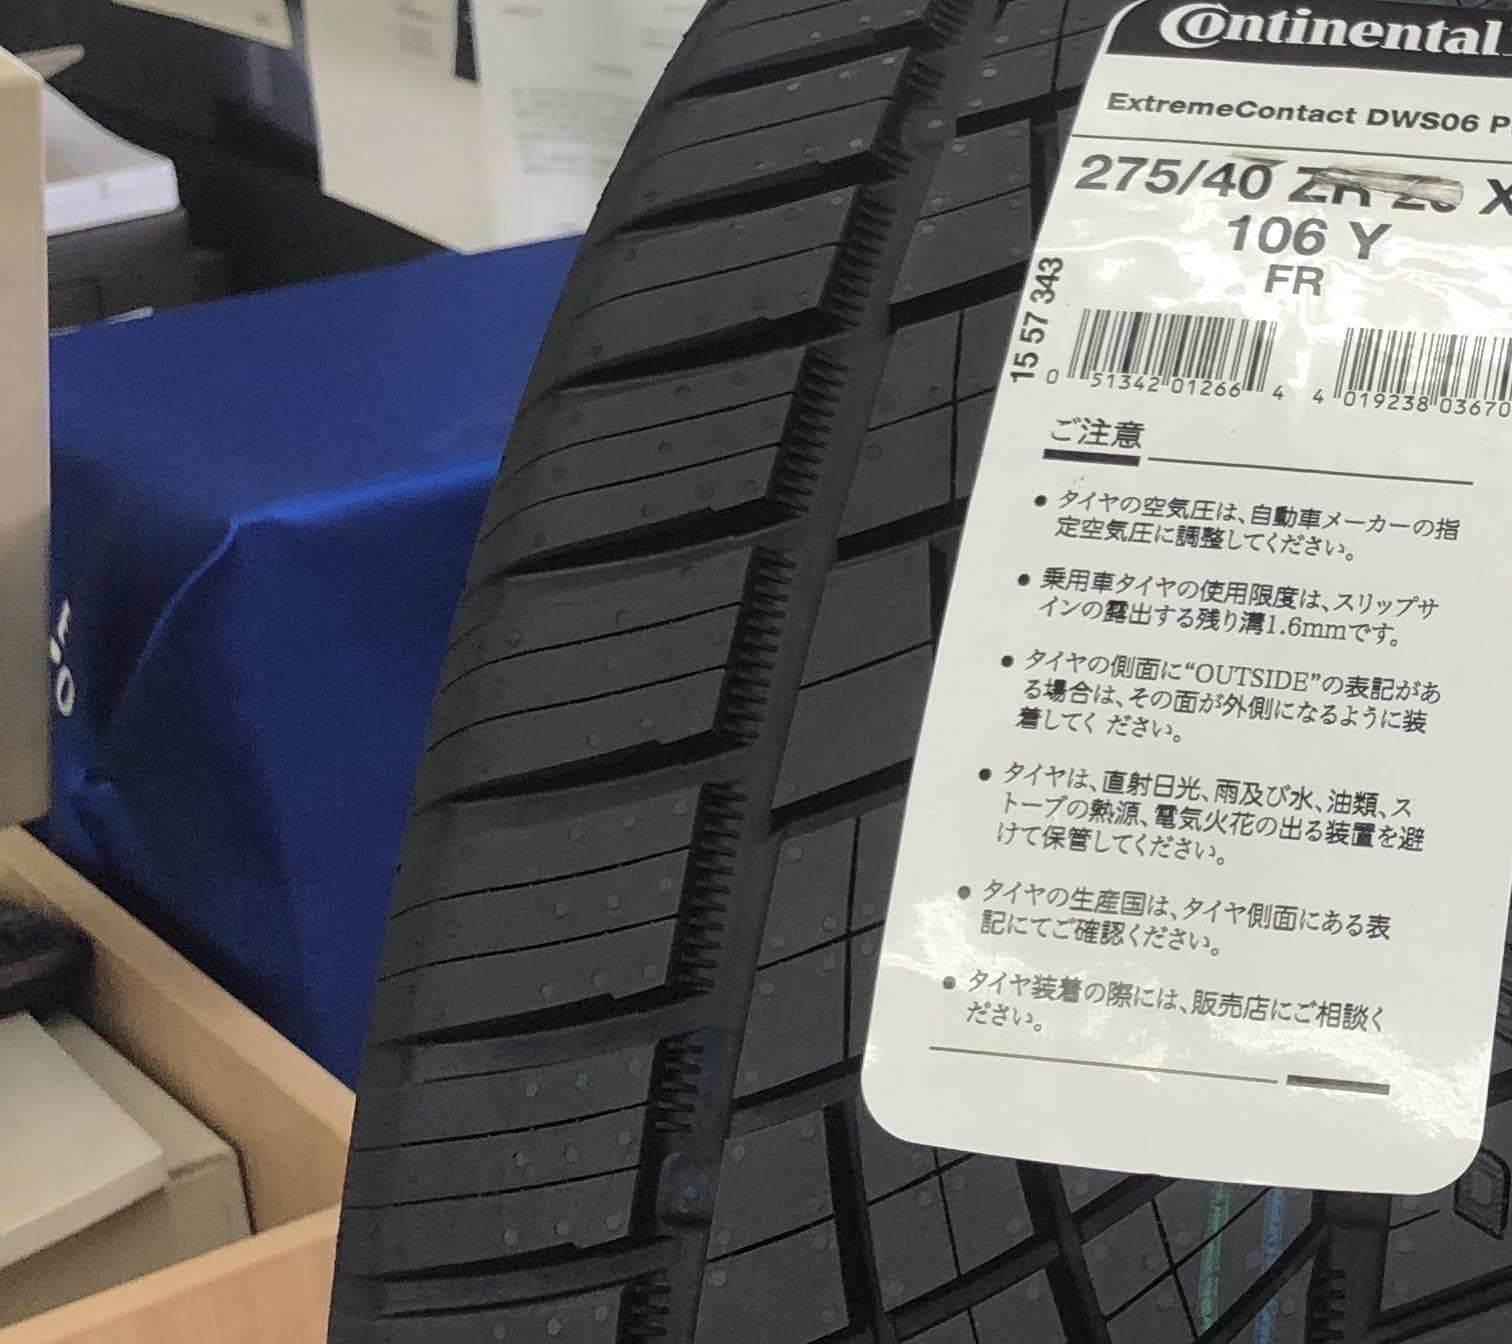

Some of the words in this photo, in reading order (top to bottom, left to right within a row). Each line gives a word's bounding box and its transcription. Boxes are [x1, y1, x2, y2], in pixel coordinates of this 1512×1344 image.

[1160, 1, 1502, 56] Continental
[1107, 92, 1357, 125] ExtremeContact
[1365, 107, 1479, 133] DWS06
[1074, 155, 1273, 200] 275/40
[1227, 215, 1327, 256] 106
[1348, 221, 1393, 260] Y
[1030, 257, 1064, 305] 343
[1263, 264, 1325, 296] FR
[1049, 418, 1145, 450] ご注意
[1053, 516, 1354, 563] 定空気圧に調整してください。
[1056, 489, 1461, 542] タイヤの空気圧は、自動車メーカーの指
[1040, 568, 1439, 621] 乗用車タイヤの使用限度は、スリップサ
[1024, 680, 1429, 735] る場合は、その面が外側になるように装
[1001, 762, 1414, 818] タイヤは、直射日光、雨及び水、油類、ス
[996, 823, 1227, 866] けて保管してください。
[1001, 793, 1426, 852] トーブの熱源、電気火花の出る装置を避
[980, 910, 1221, 958] 記にてご確認ください。
[983, 880, 1391, 941] タイヤの生産国は、タイヤ側面にある表
[965, 1002, 1044, 1032] ださい。
[967, 970, 1385, 1033] タイヤ装着の際には、販売店にご相談く
